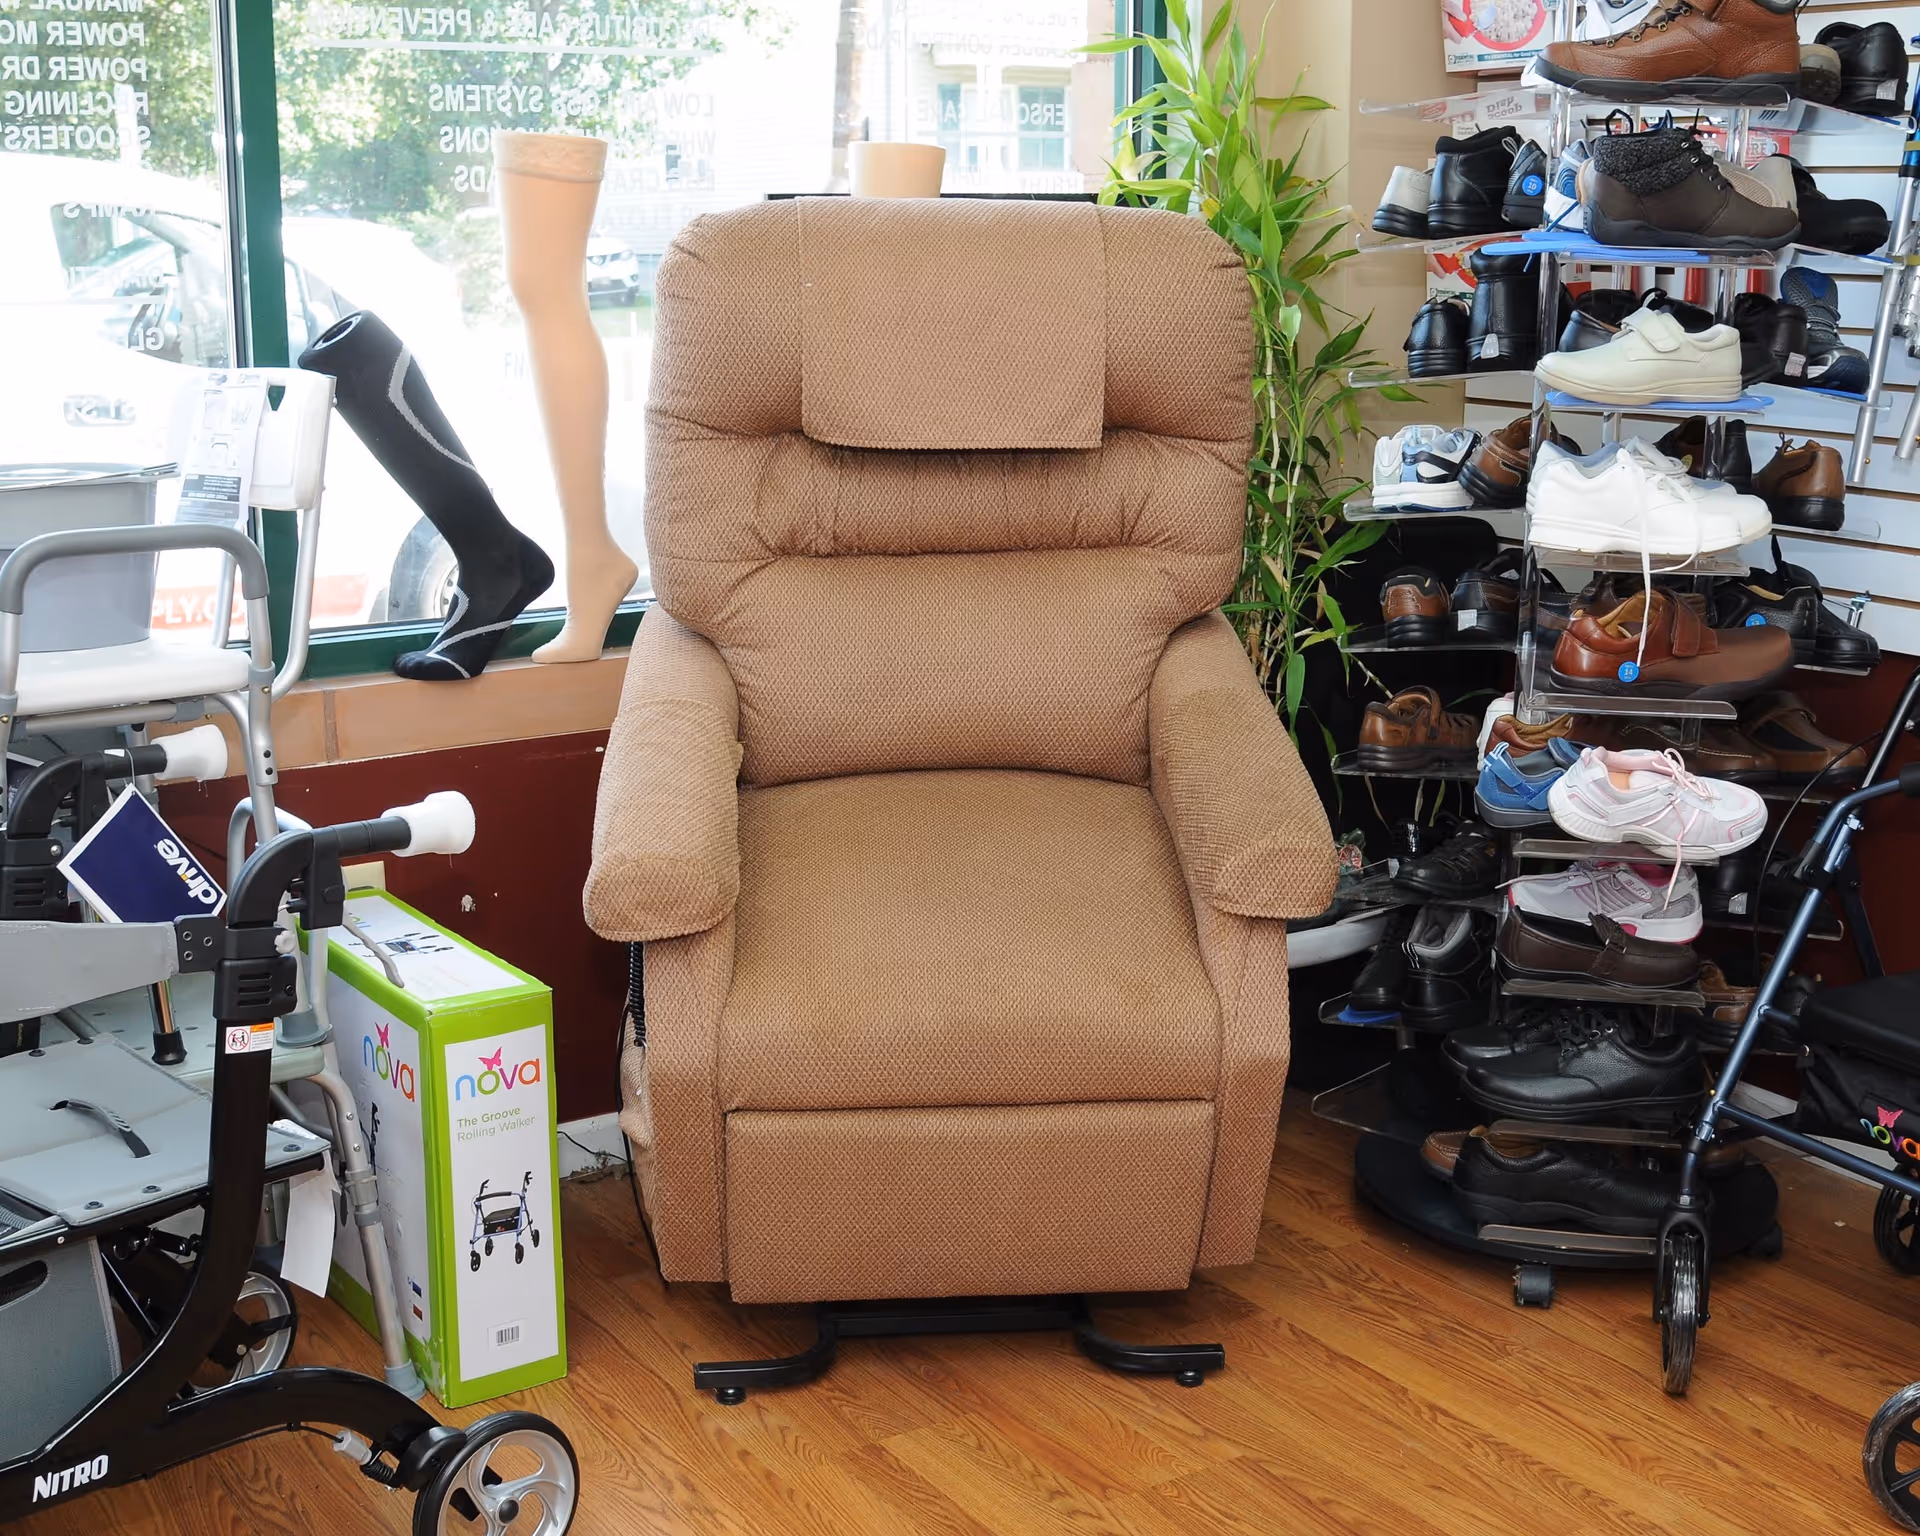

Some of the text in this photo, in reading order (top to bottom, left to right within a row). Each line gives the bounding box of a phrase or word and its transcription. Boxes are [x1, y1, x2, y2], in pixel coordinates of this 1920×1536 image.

[157, 838, 218, 905] drive
[363, 1035, 415, 1102] nova
[455, 1058, 541, 1101] nova
[457, 1106, 521, 1129] The Groove
[457, 1115, 535, 1142] Rolling Walker
[1860, 1118, 1920, 1161] nova
[32, 1454, 109, 1503] NITRO
